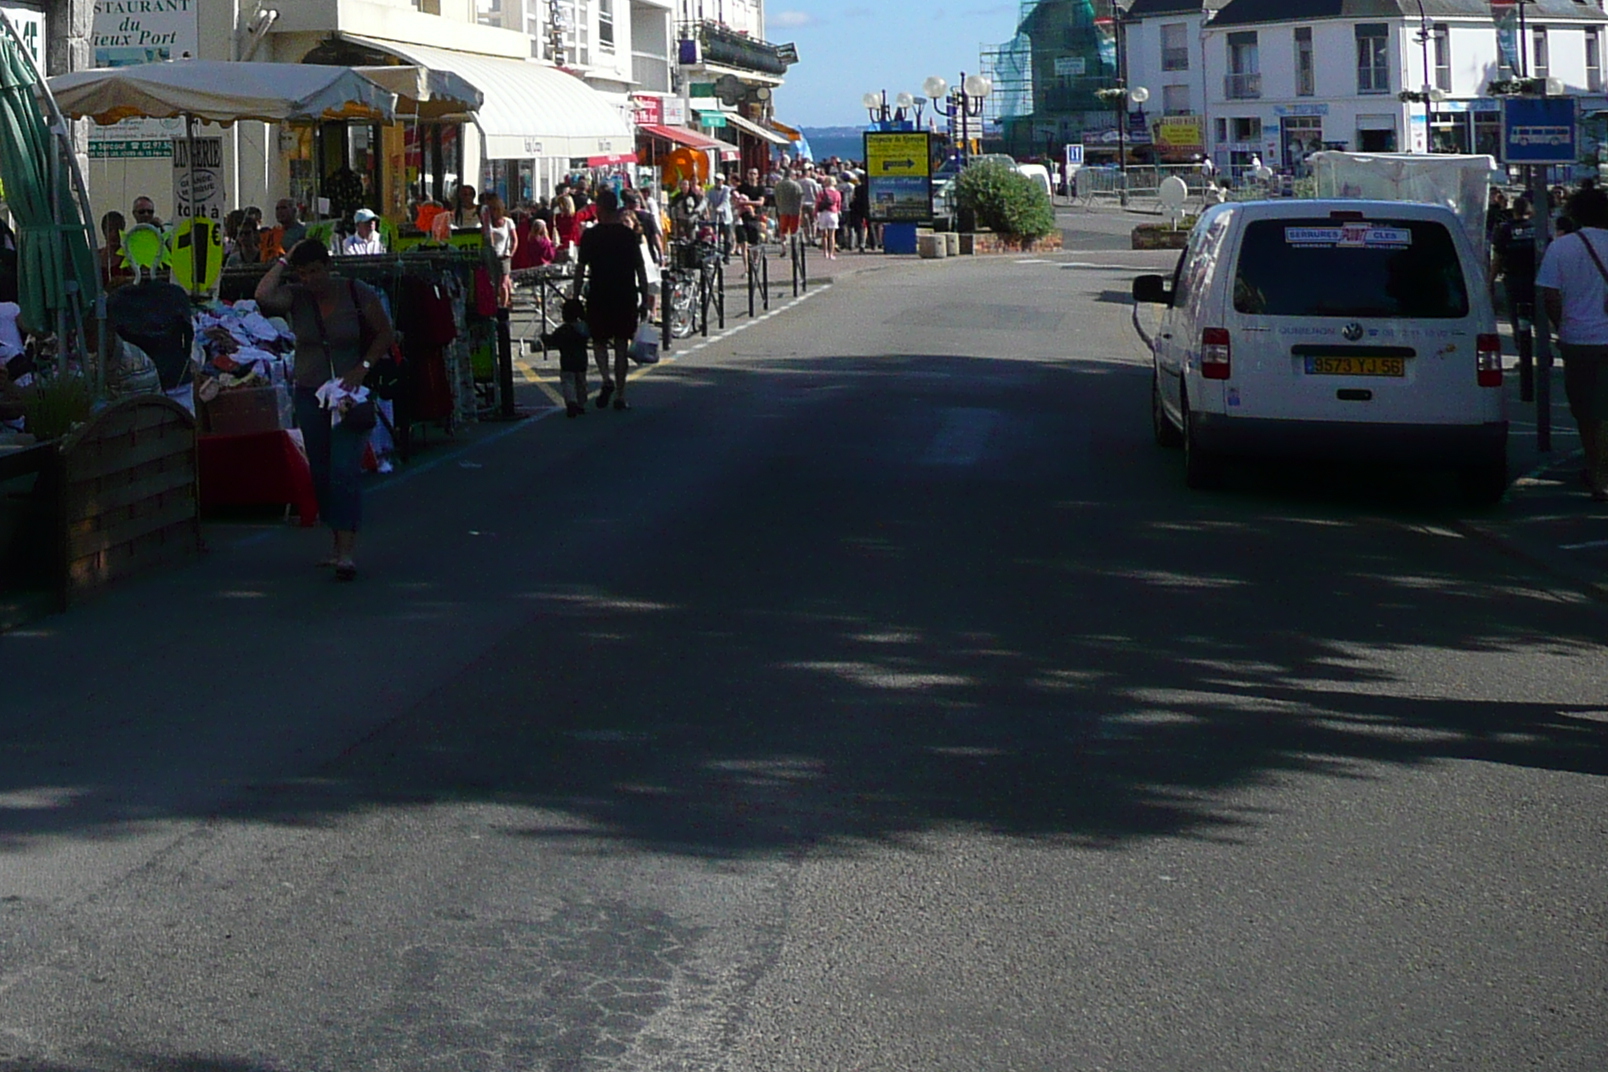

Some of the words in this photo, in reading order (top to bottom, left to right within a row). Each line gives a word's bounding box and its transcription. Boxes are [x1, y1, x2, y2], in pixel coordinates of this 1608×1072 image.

[119, 17, 140, 32] du
[93, 32, 131, 46] ieux
[138, 30, 176, 45] Port
[211, 204, 219, 219] à
[178, 222, 209, 284] 1
[212, 223, 221, 246] €
[1314, 357, 1352, 371] 9573
[1358, 358, 1377, 372] YJ
